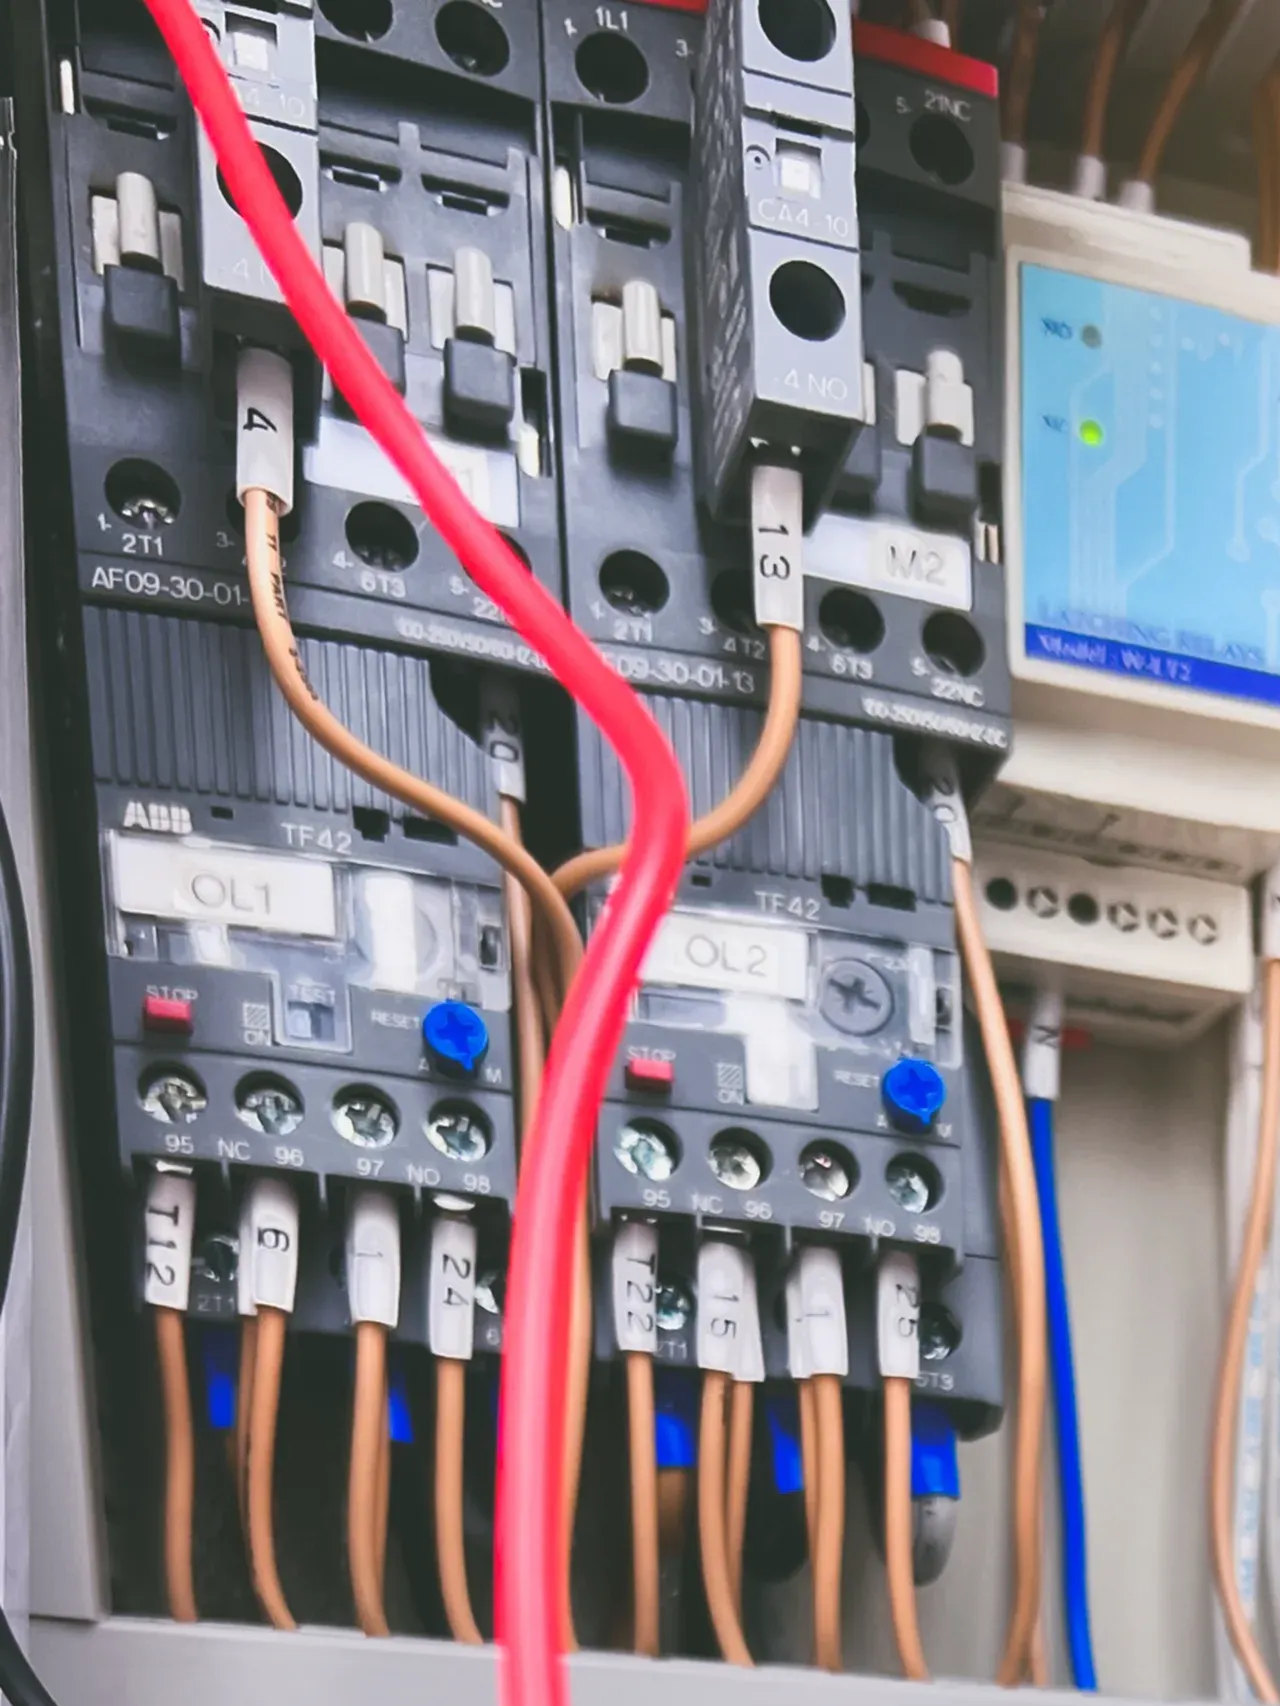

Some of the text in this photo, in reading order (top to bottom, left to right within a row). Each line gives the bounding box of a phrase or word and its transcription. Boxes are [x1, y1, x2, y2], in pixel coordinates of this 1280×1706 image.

[595, 8, 628, 31] 1L1
[758, 198, 849, 238] CA4-10
[808, 373, 848, 401] NO
[243, 407, 277, 431] 4
[122, 535, 164, 556] 2T1
[360, 571, 406, 597] 6T3
[757, 523, 791, 581] 13
[887, 544, 946, 586] M2
[91, 567, 249, 606] AF09-30-01-
[613, 618, 652, 643] 2T1
[830, 653, 873, 680] 6T3
[124, 801, 193, 834] ABB
[280, 822, 352, 855] TF42
[191, 873, 272, 914] OL1
[754, 891, 821, 921] TF42
[685, 934, 768, 978] OL2
[146, 985, 199, 1001] STOP
[243, 1029, 271, 1047] ON
[371, 1009, 420, 1030] RESET
[627, 1047, 676, 1064] STOP
[718, 1088, 745, 1106] ON
[165, 1133, 491, 1194] 95 NC 96 97 NO 98
[643, 1188, 942, 1244] 95 NC 96 97 NO 98
[146, 1205, 180, 1286] T12
[442, 1253, 472, 1306] 24
[626, 1254, 656, 1334] T22
[710, 1294, 740, 1341] 15
